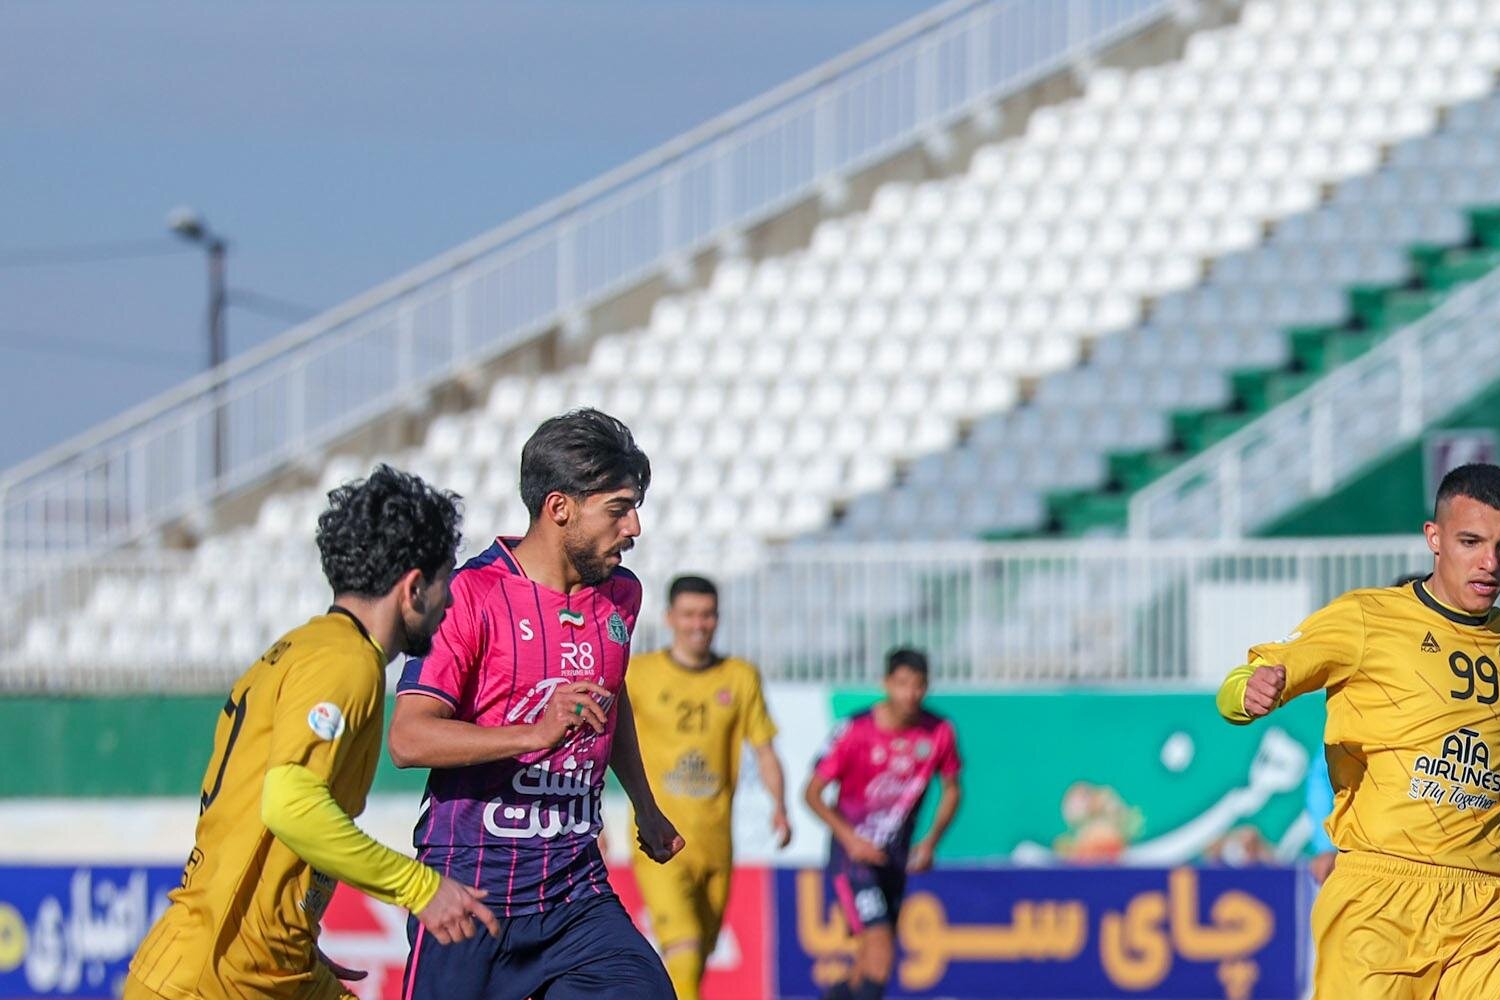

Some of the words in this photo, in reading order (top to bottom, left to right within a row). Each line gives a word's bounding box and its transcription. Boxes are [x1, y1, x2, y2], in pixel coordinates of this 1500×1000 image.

[560, 642, 595, 670] R8
[1449, 650, 1500, 705] 99
[676, 700, 707, 733] 21
[1442, 728, 1490, 770] ATA
[1414, 756, 1500, 792] AIRLINES
[1421, 780, 1446, 805] Fly
